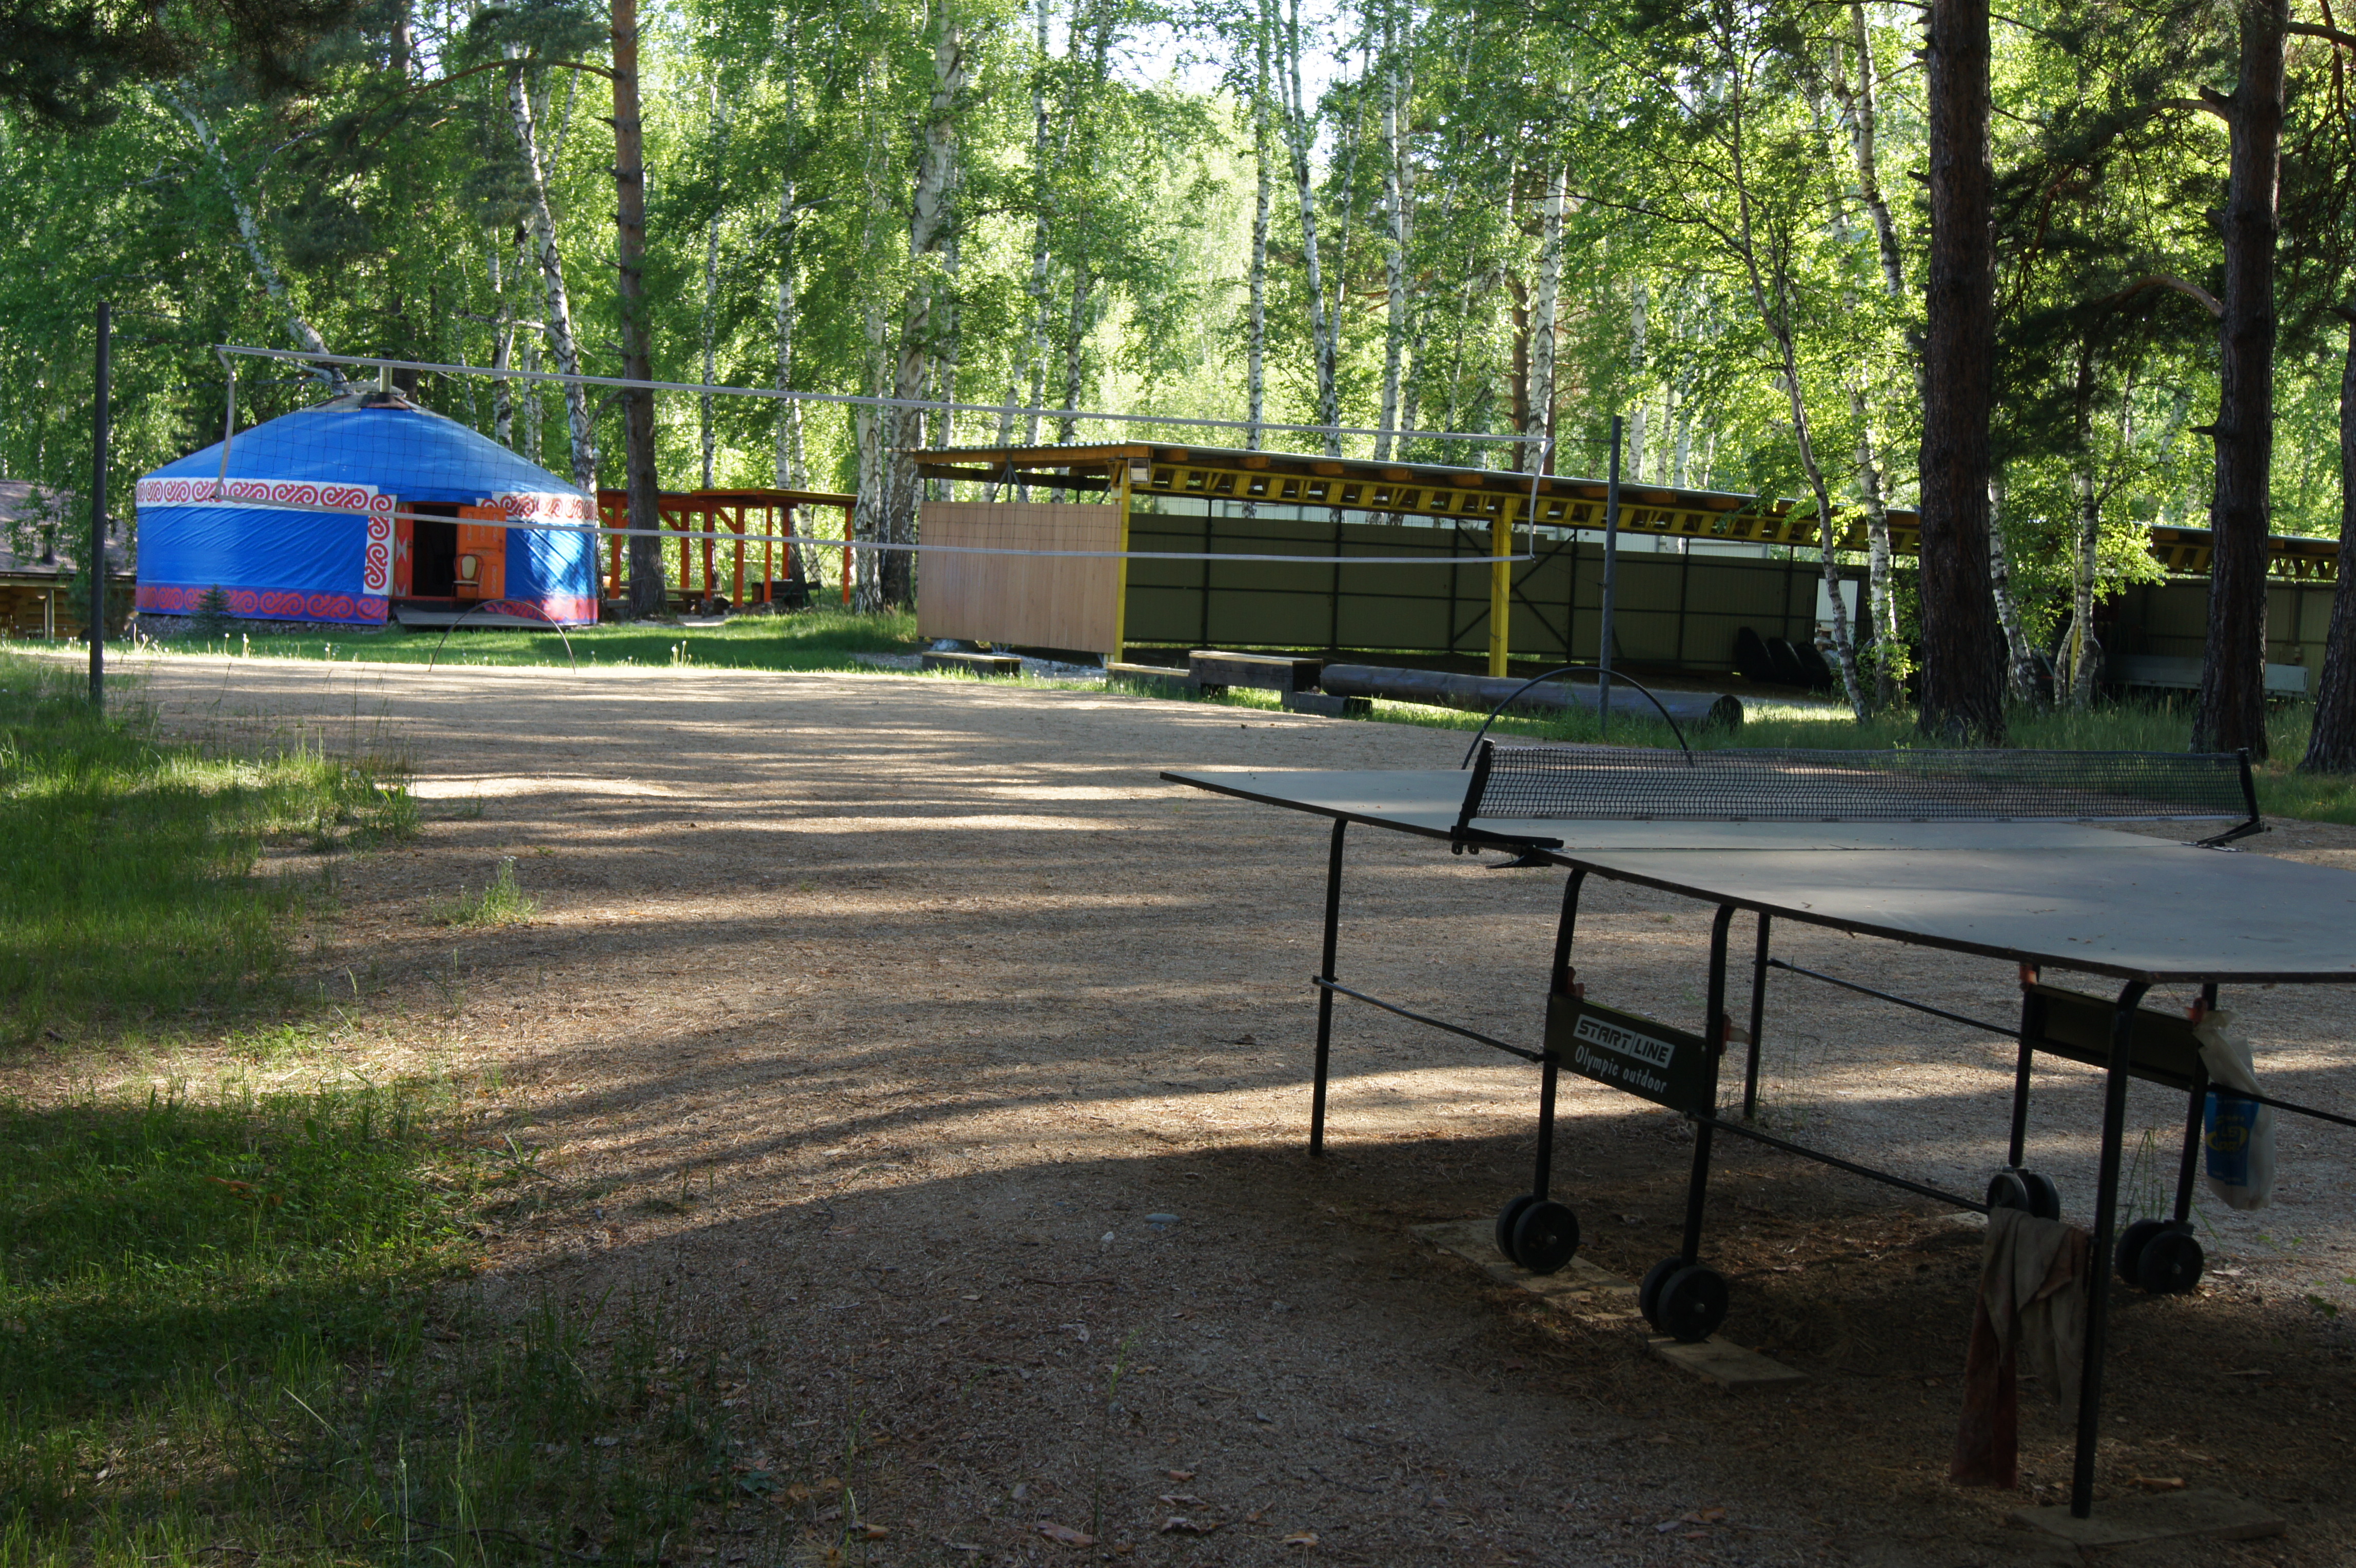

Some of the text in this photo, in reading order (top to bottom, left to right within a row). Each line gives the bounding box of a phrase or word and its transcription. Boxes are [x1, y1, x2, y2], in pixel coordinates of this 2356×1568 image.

[1578, 1019, 1670, 1063] START LINE
[1575, 1045, 1667, 1093] Olympic outdoor
